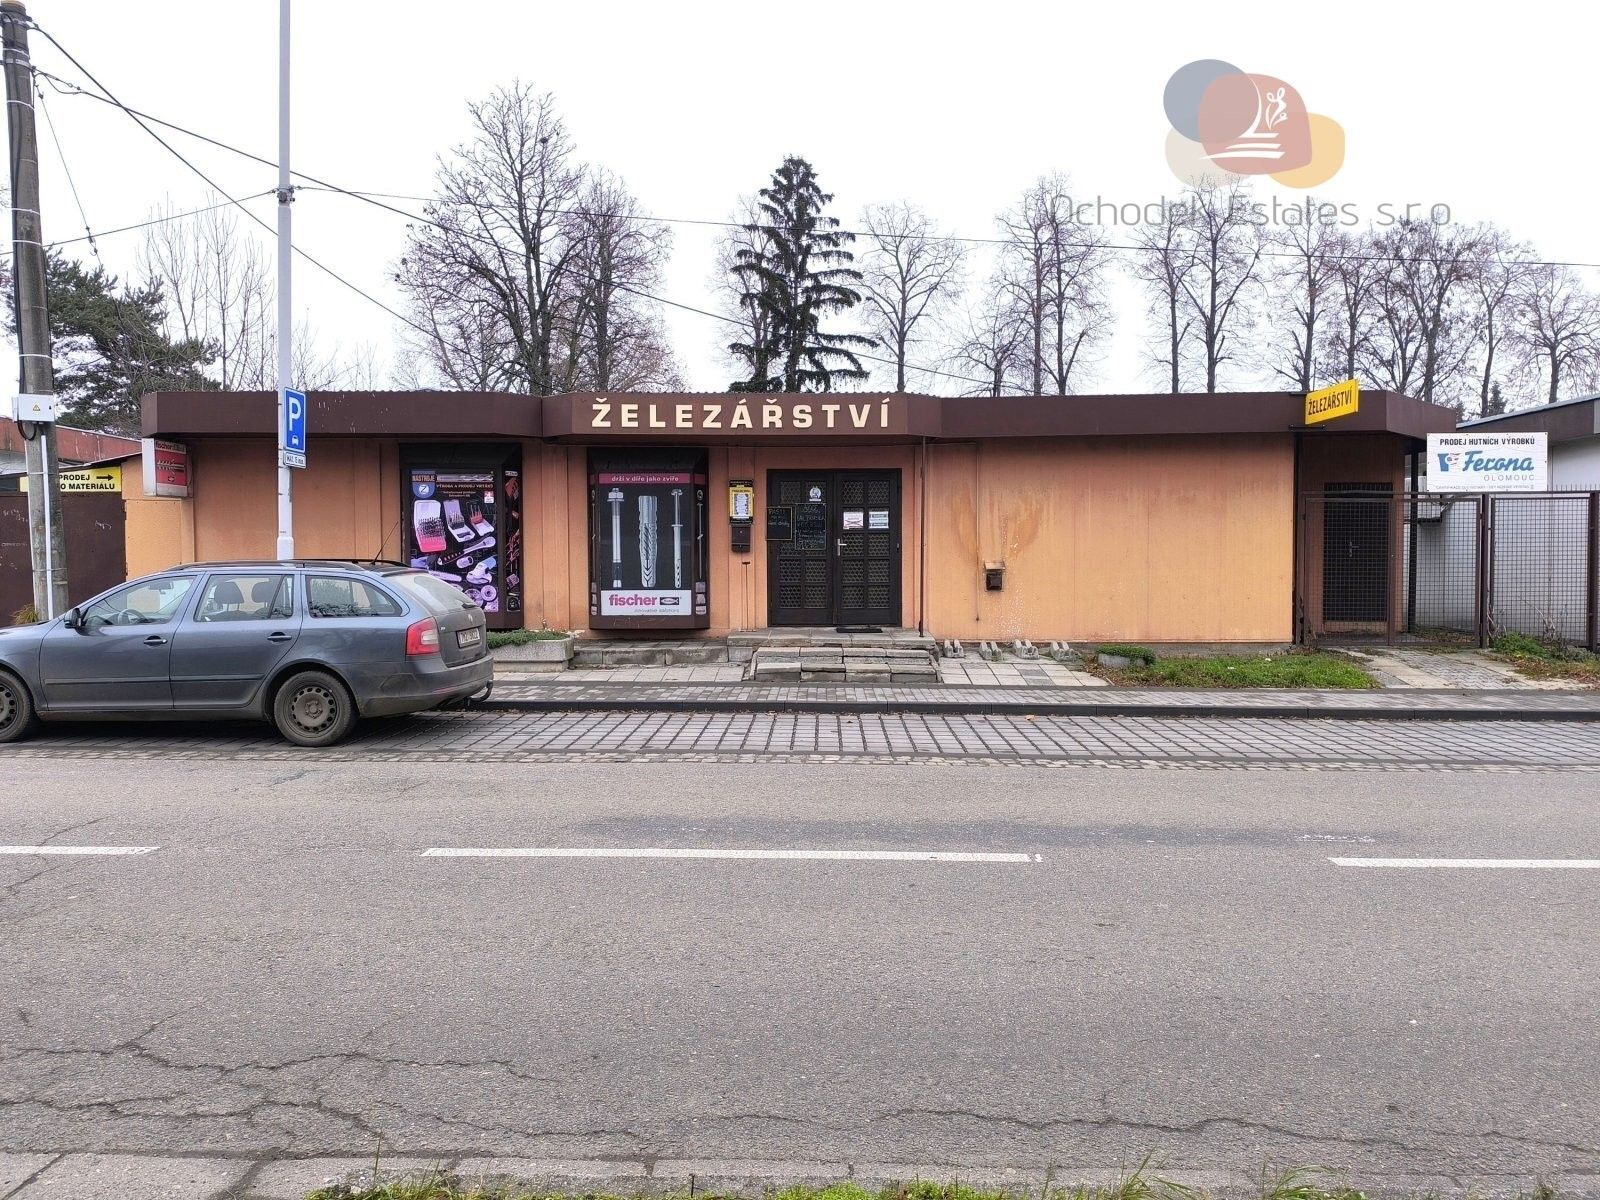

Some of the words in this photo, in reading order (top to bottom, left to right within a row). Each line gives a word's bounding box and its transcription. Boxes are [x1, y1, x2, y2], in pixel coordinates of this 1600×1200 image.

[1308, 385, 1353, 416] ŽELEZÁŘSTVÍ
[289, 396, 301, 431] P
[591, 397, 890, 429] ŽELEZÁŘSTVÍ
[1440, 438, 1467, 446] PRODEJ
[1468, 436, 1498, 446] HUTNÍCH
[1502, 435, 1535, 445] VÝROBKŮ
[1462, 450, 1535, 472] Ferona
[1483, 474, 1535, 482] OLOMOUC
[608, 594, 657, 606] fischer
